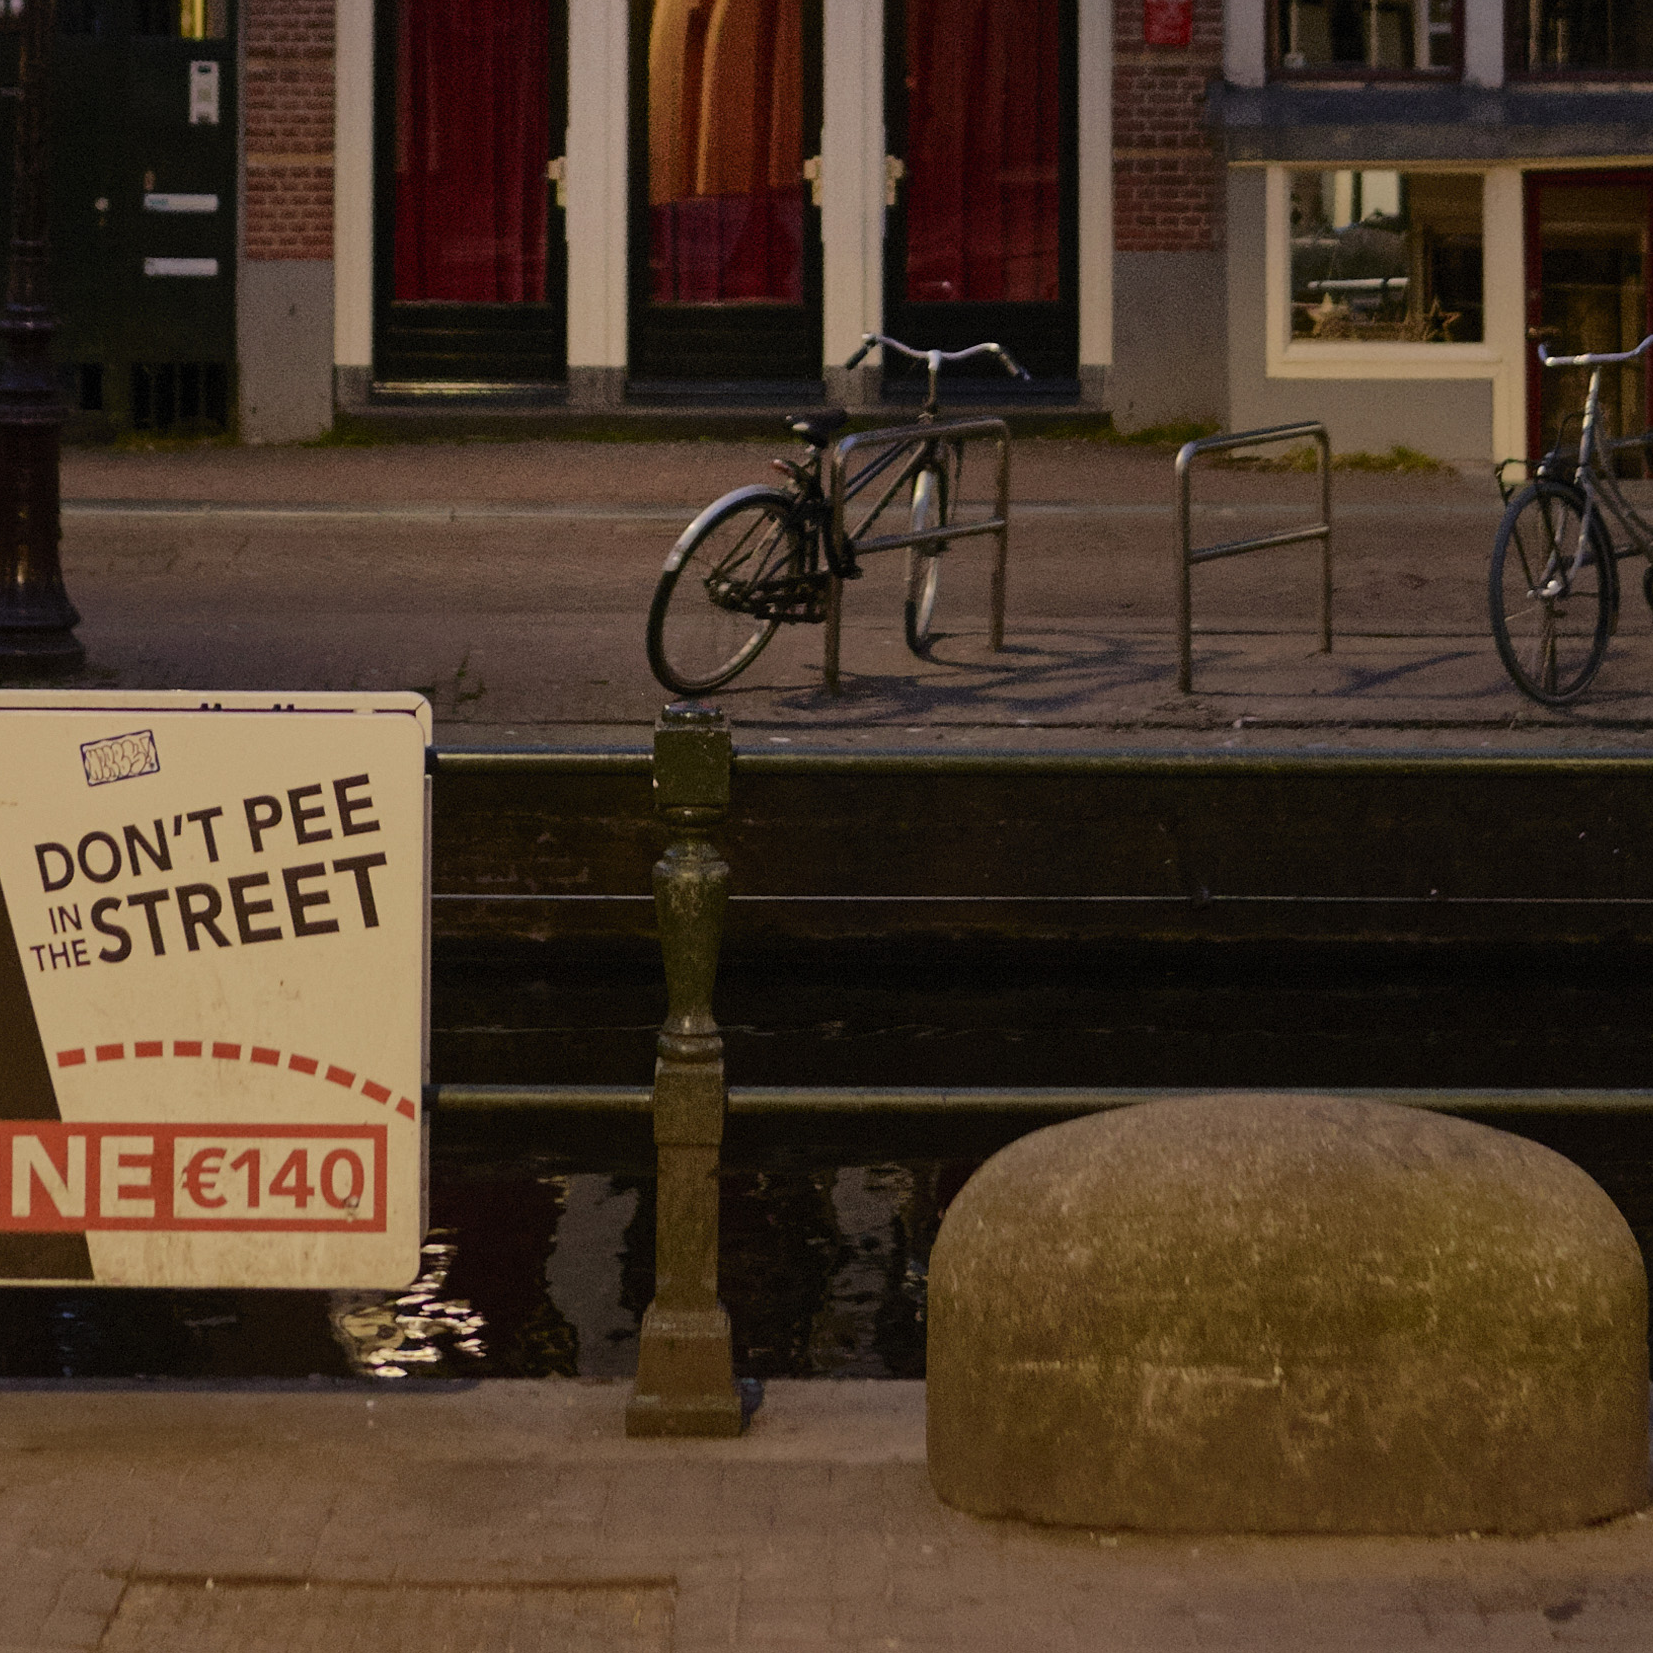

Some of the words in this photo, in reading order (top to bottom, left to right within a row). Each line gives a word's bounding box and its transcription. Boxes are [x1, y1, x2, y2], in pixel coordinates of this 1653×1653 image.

[33, 805, 224, 894] DON'T
[242, 772, 382, 854] PEE
[48, 902, 84, 935] IN
[89, 850, 389, 965] STREET
[29, 938, 92, 973] THE
[181, 1147, 365, 1210] €140
